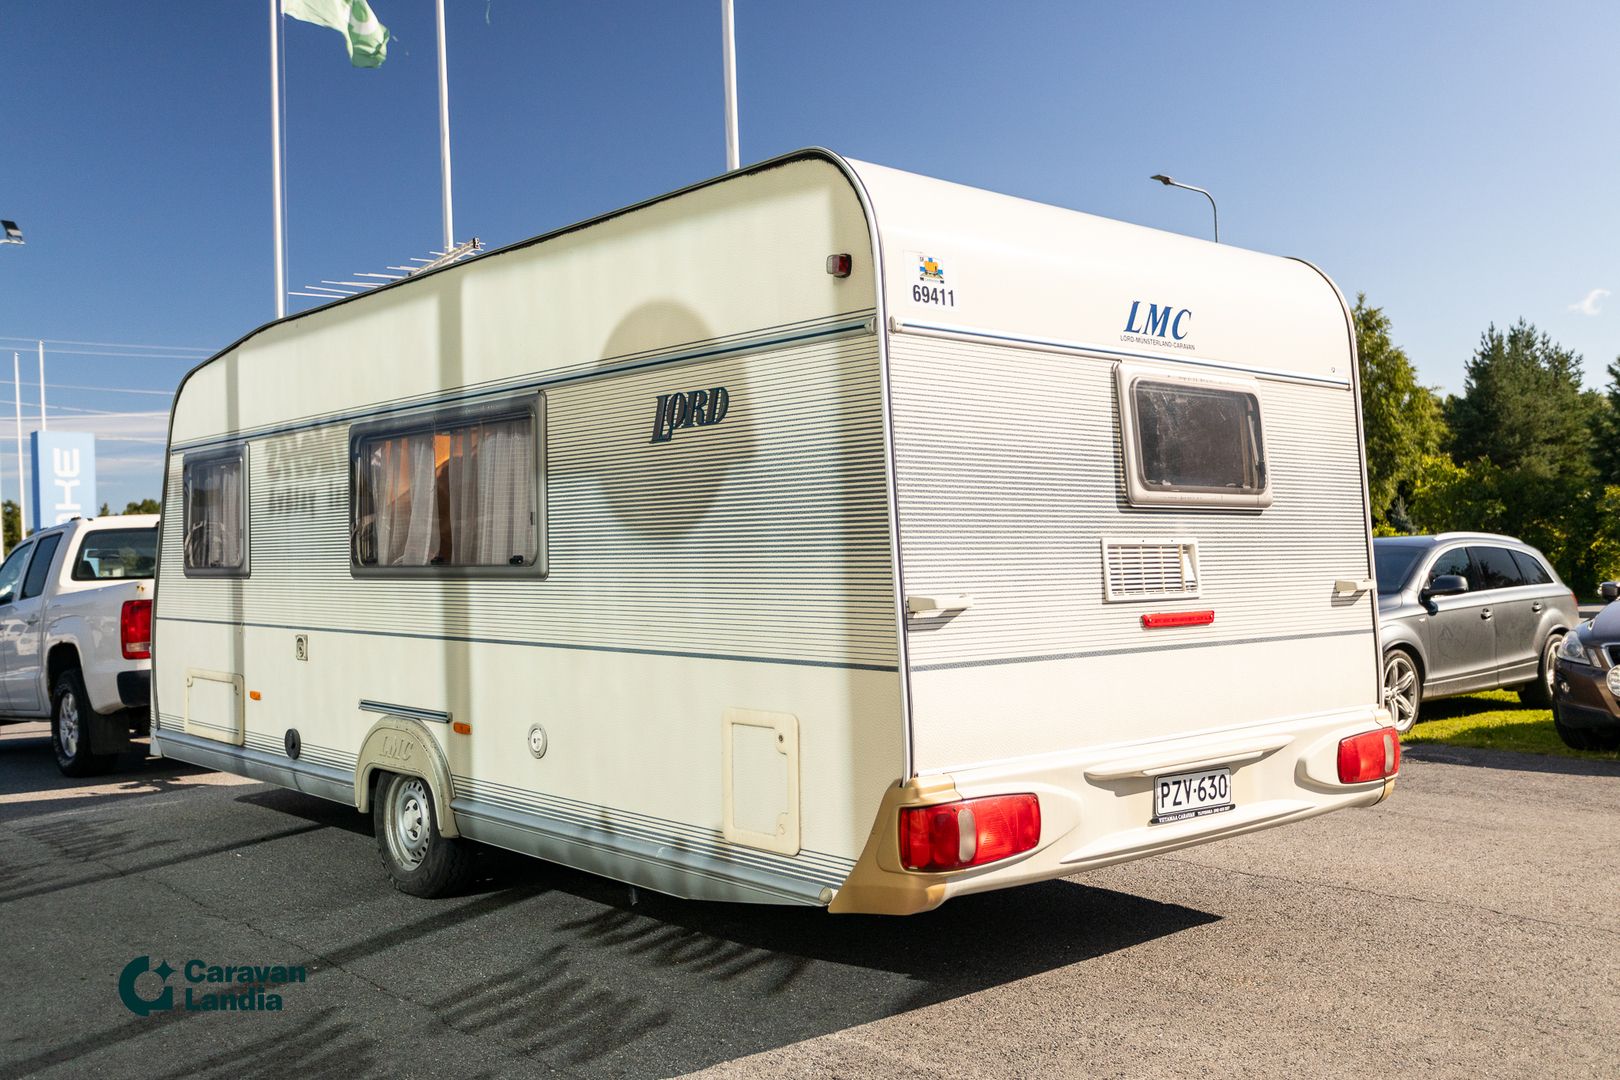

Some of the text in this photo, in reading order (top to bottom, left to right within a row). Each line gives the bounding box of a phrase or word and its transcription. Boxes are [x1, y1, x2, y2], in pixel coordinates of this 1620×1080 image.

[912, 284, 954, 307] 69411
[1123, 300, 1192, 340] LMC
[649, 386, 730, 444] LORD
[1160, 773, 1228, 809] PZV-630
